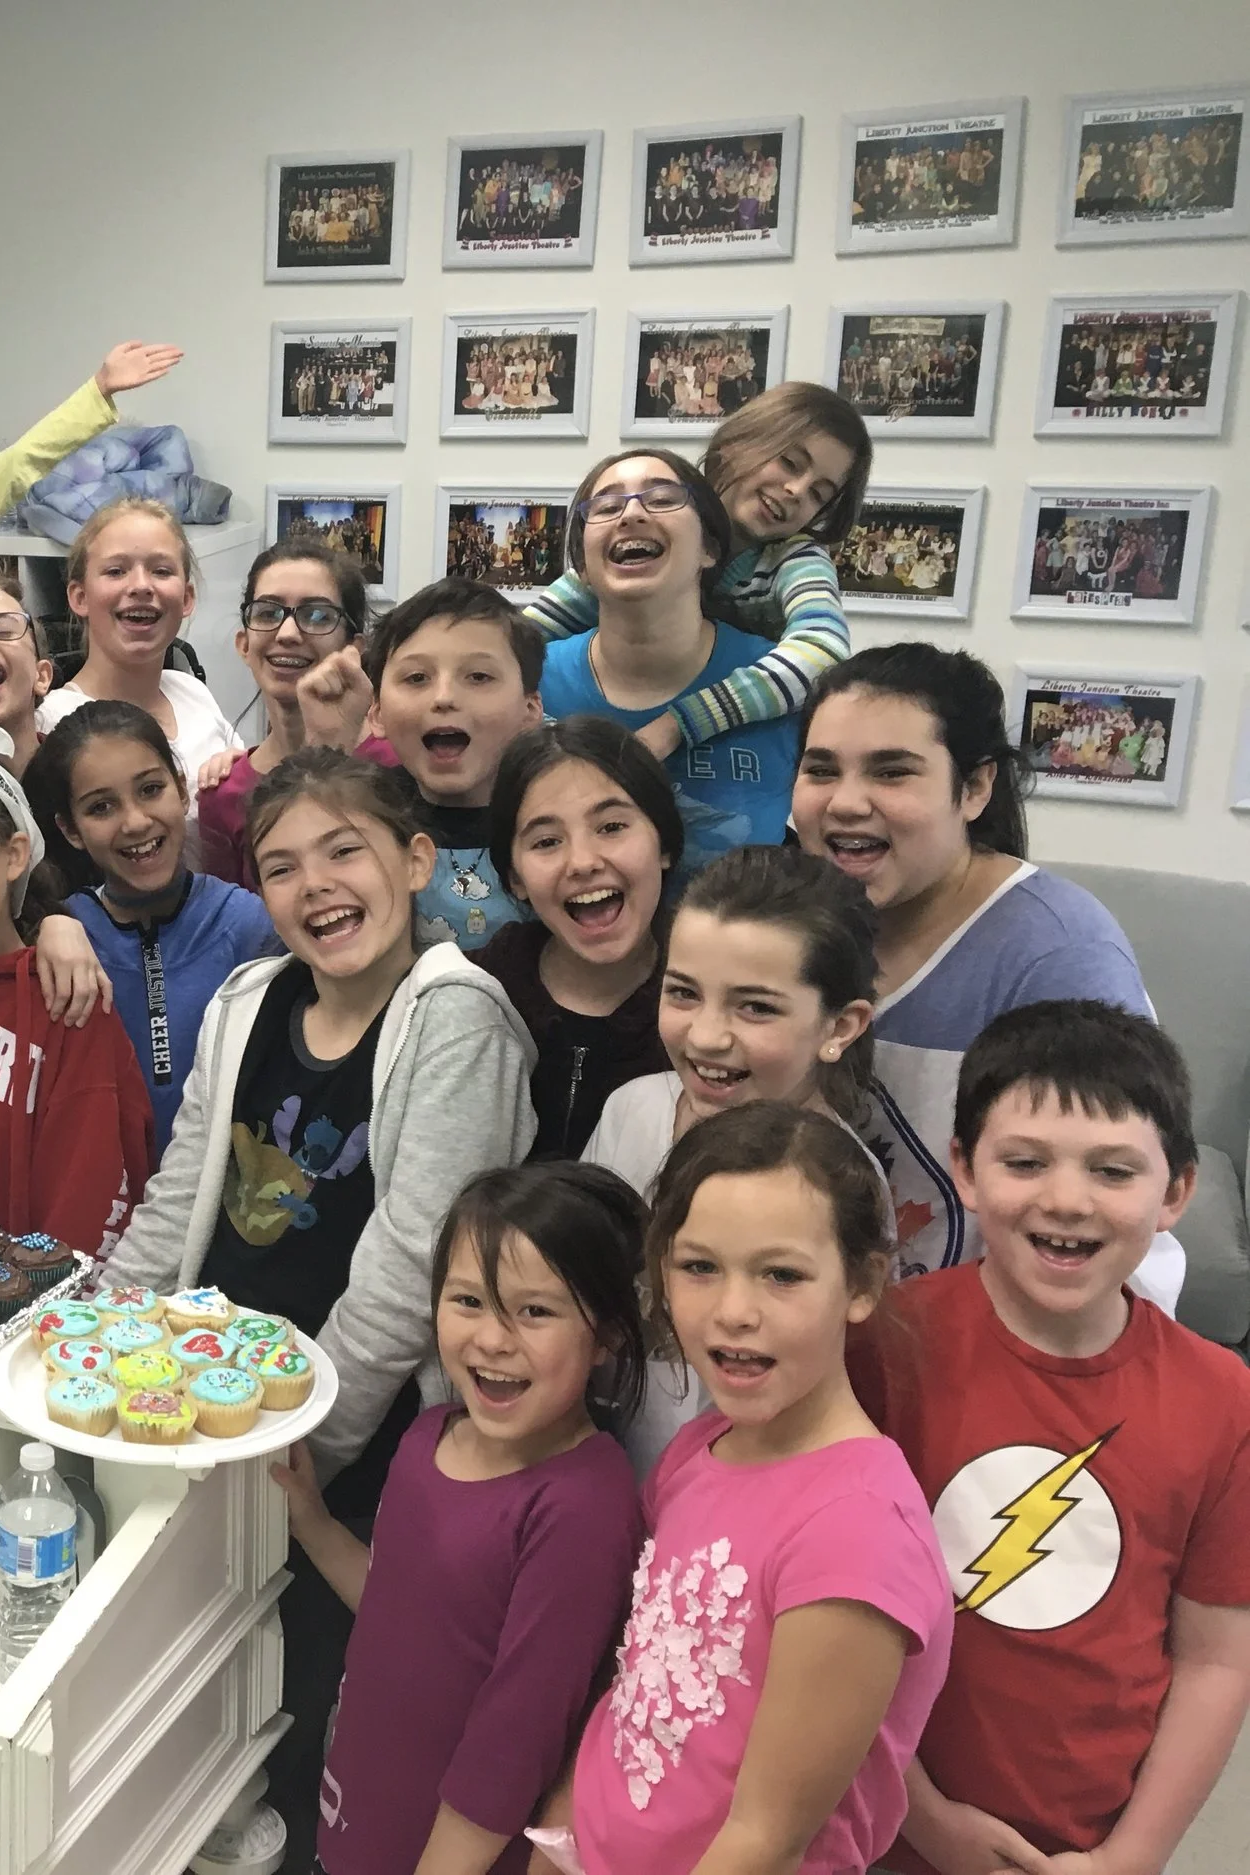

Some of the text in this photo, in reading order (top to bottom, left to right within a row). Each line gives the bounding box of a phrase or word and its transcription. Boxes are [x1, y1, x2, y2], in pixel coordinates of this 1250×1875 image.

[1092, 104, 1234, 123] LIBERTY JUNCTION THEATRE
[866, 118, 996, 138] LIBERTY JUNCTION THEATRE
[1056, 498, 1085, 509] Liberty
[1086, 499, 1122, 508] Junction
[1123, 500, 1155, 509] Theatre
[1040, 680, 1161, 697] Liberty Junction Theatre
[150, 1015, 172, 1075] CHEER
